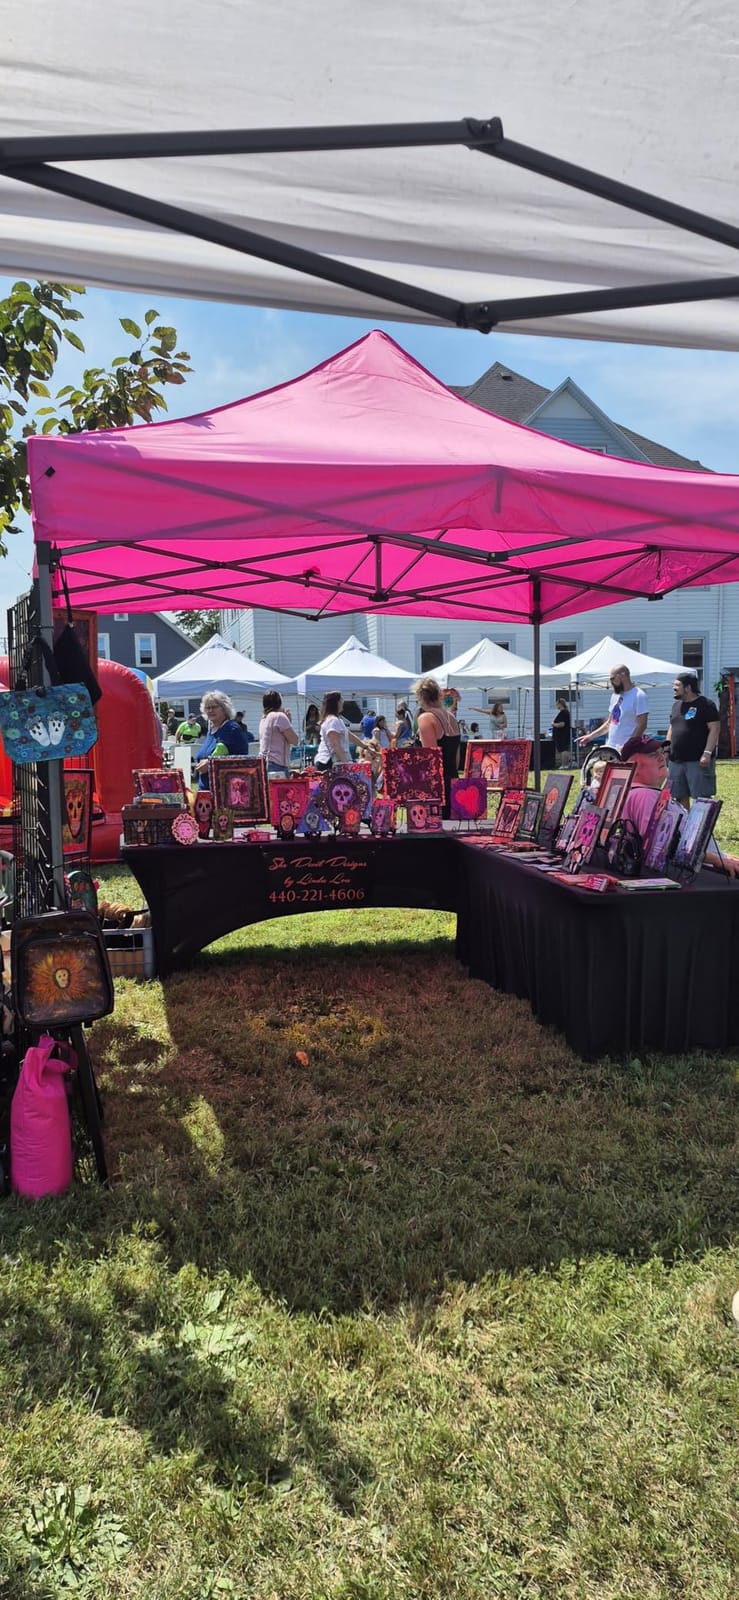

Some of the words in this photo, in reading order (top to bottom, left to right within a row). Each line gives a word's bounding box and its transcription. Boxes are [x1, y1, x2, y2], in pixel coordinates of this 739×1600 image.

[269, 857, 287, 871] She
[326, 856, 368, 871] Designs
[284, 876, 294, 888] by
[296, 873, 327, 885] Linda
[269, 888, 365, 902] 440-221-4606
